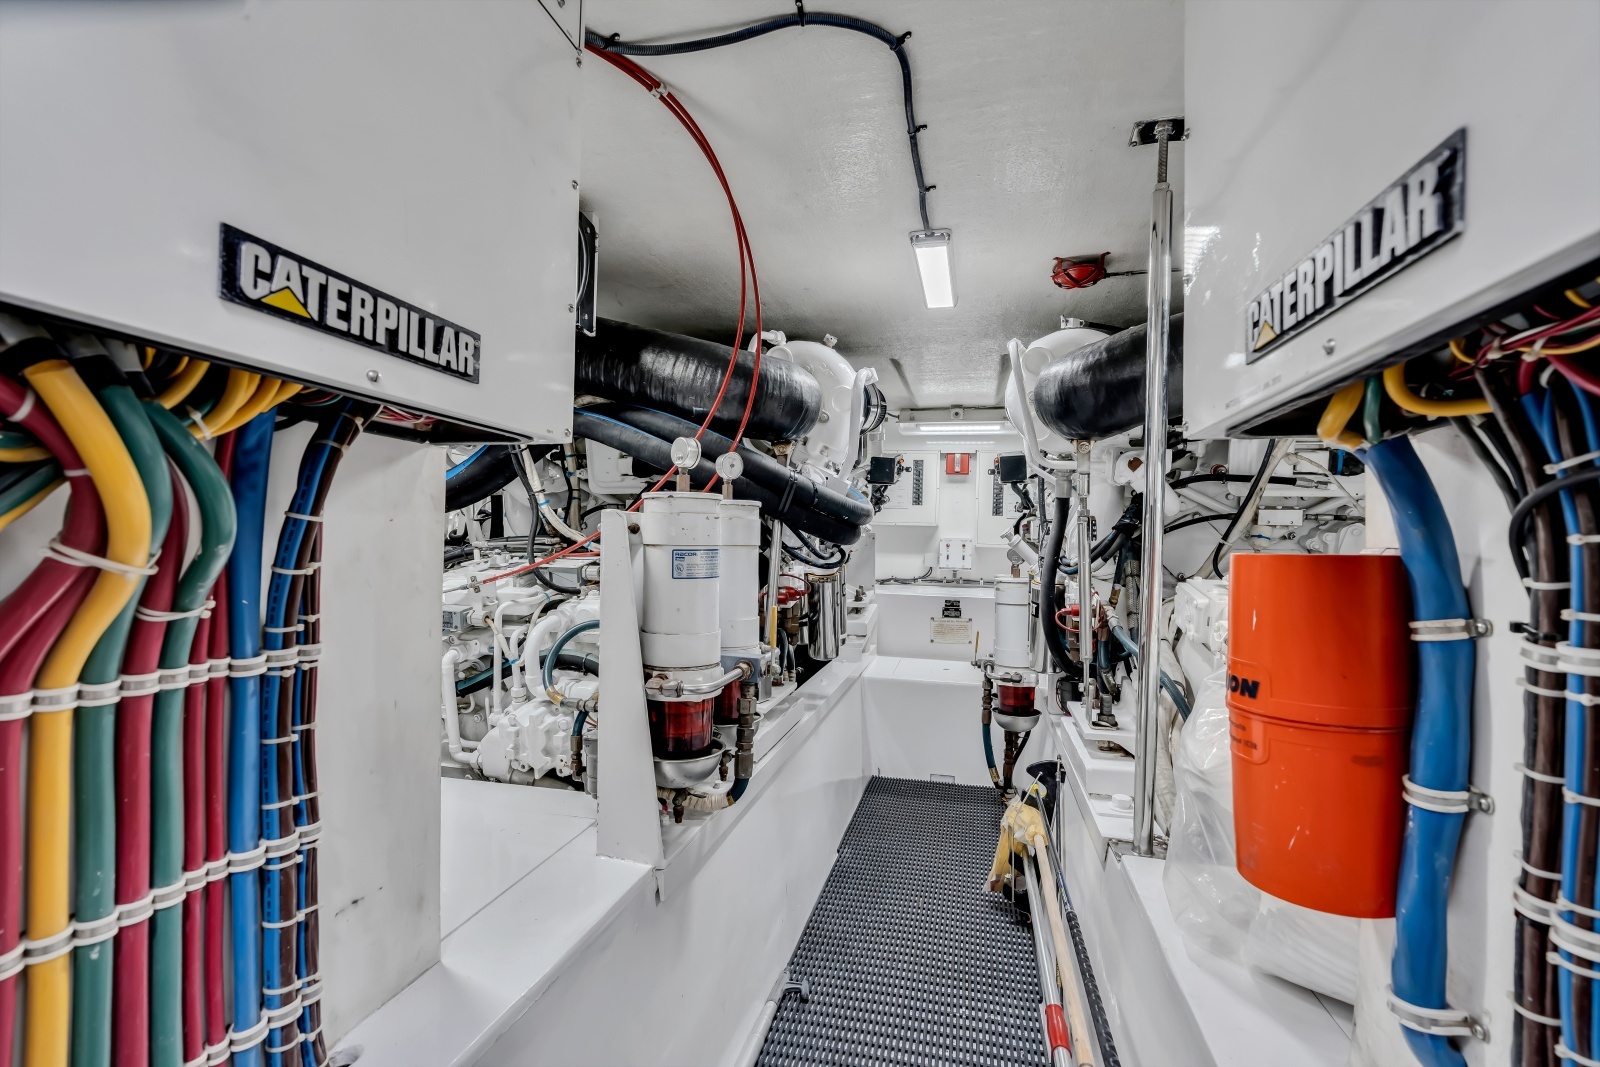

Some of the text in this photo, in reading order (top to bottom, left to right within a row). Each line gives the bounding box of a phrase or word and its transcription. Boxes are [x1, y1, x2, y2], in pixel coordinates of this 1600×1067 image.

[239, 241, 475, 376] CATERPILLAR
[1249, 161, 1441, 346] CATERPILLAR
[1227, 673, 1260, 699] ON
